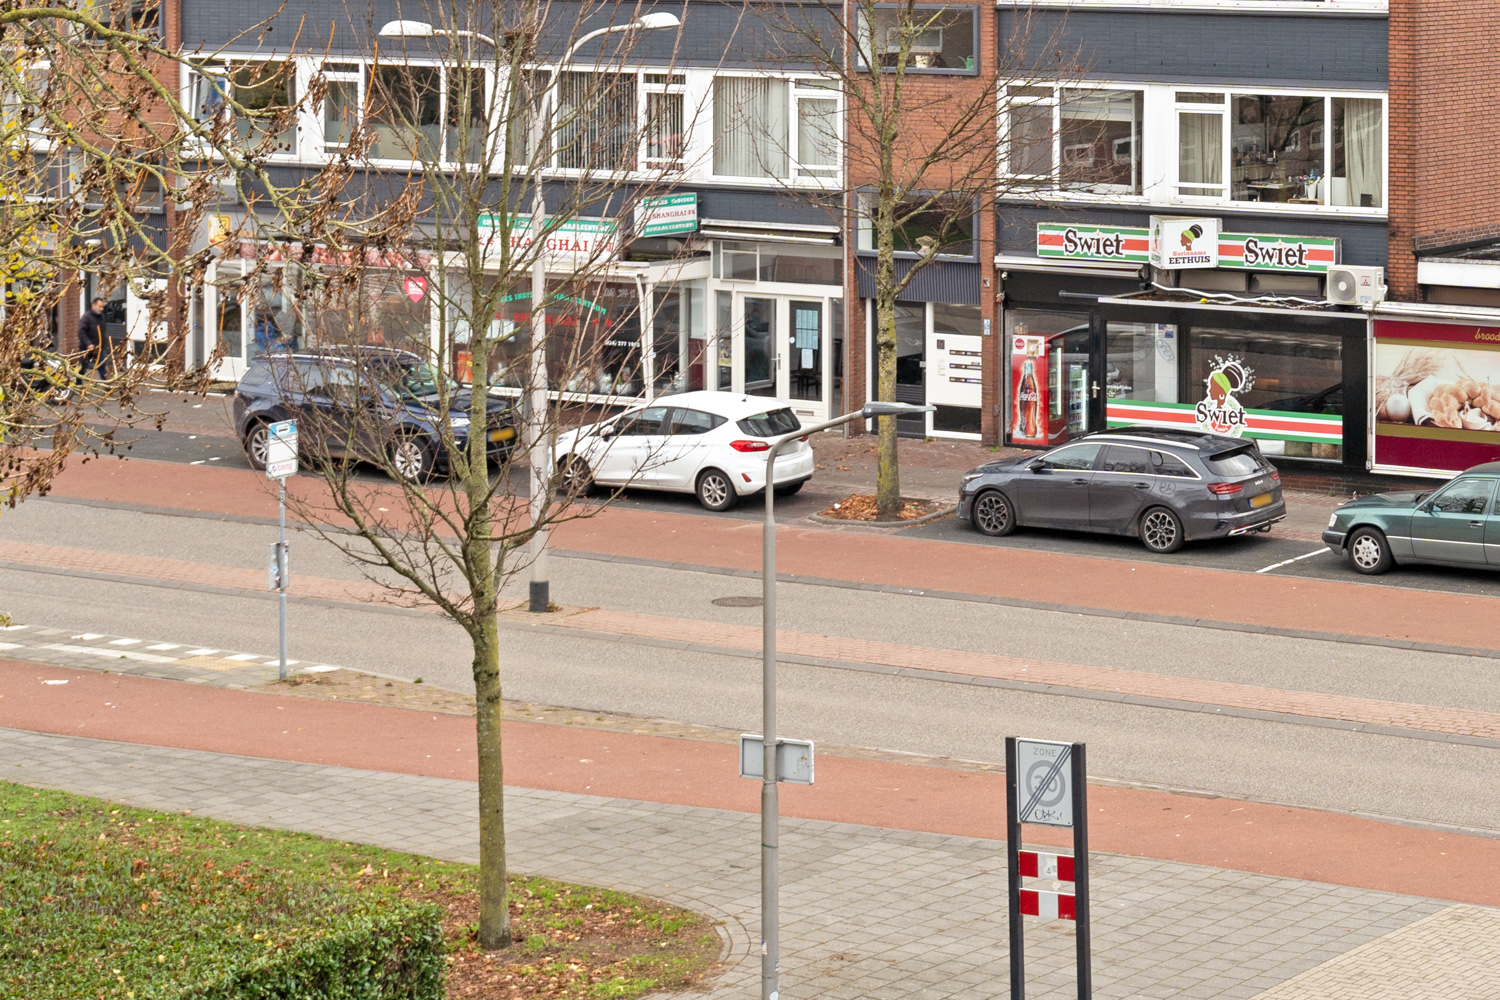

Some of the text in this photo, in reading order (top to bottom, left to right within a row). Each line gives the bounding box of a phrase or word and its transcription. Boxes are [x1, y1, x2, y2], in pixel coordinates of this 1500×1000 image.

[652, 210, 687, 219] SHANGHAI
[1064, 229, 1124, 256] Swiet
[1168, 255, 1211, 265] EETHUIS
[1244, 239, 1308, 267] Swiet
[1196, 402, 1246, 426] Swiet
[1033, 747, 1058, 758] ZONE
[1034, 774, 1058, 793] 30
